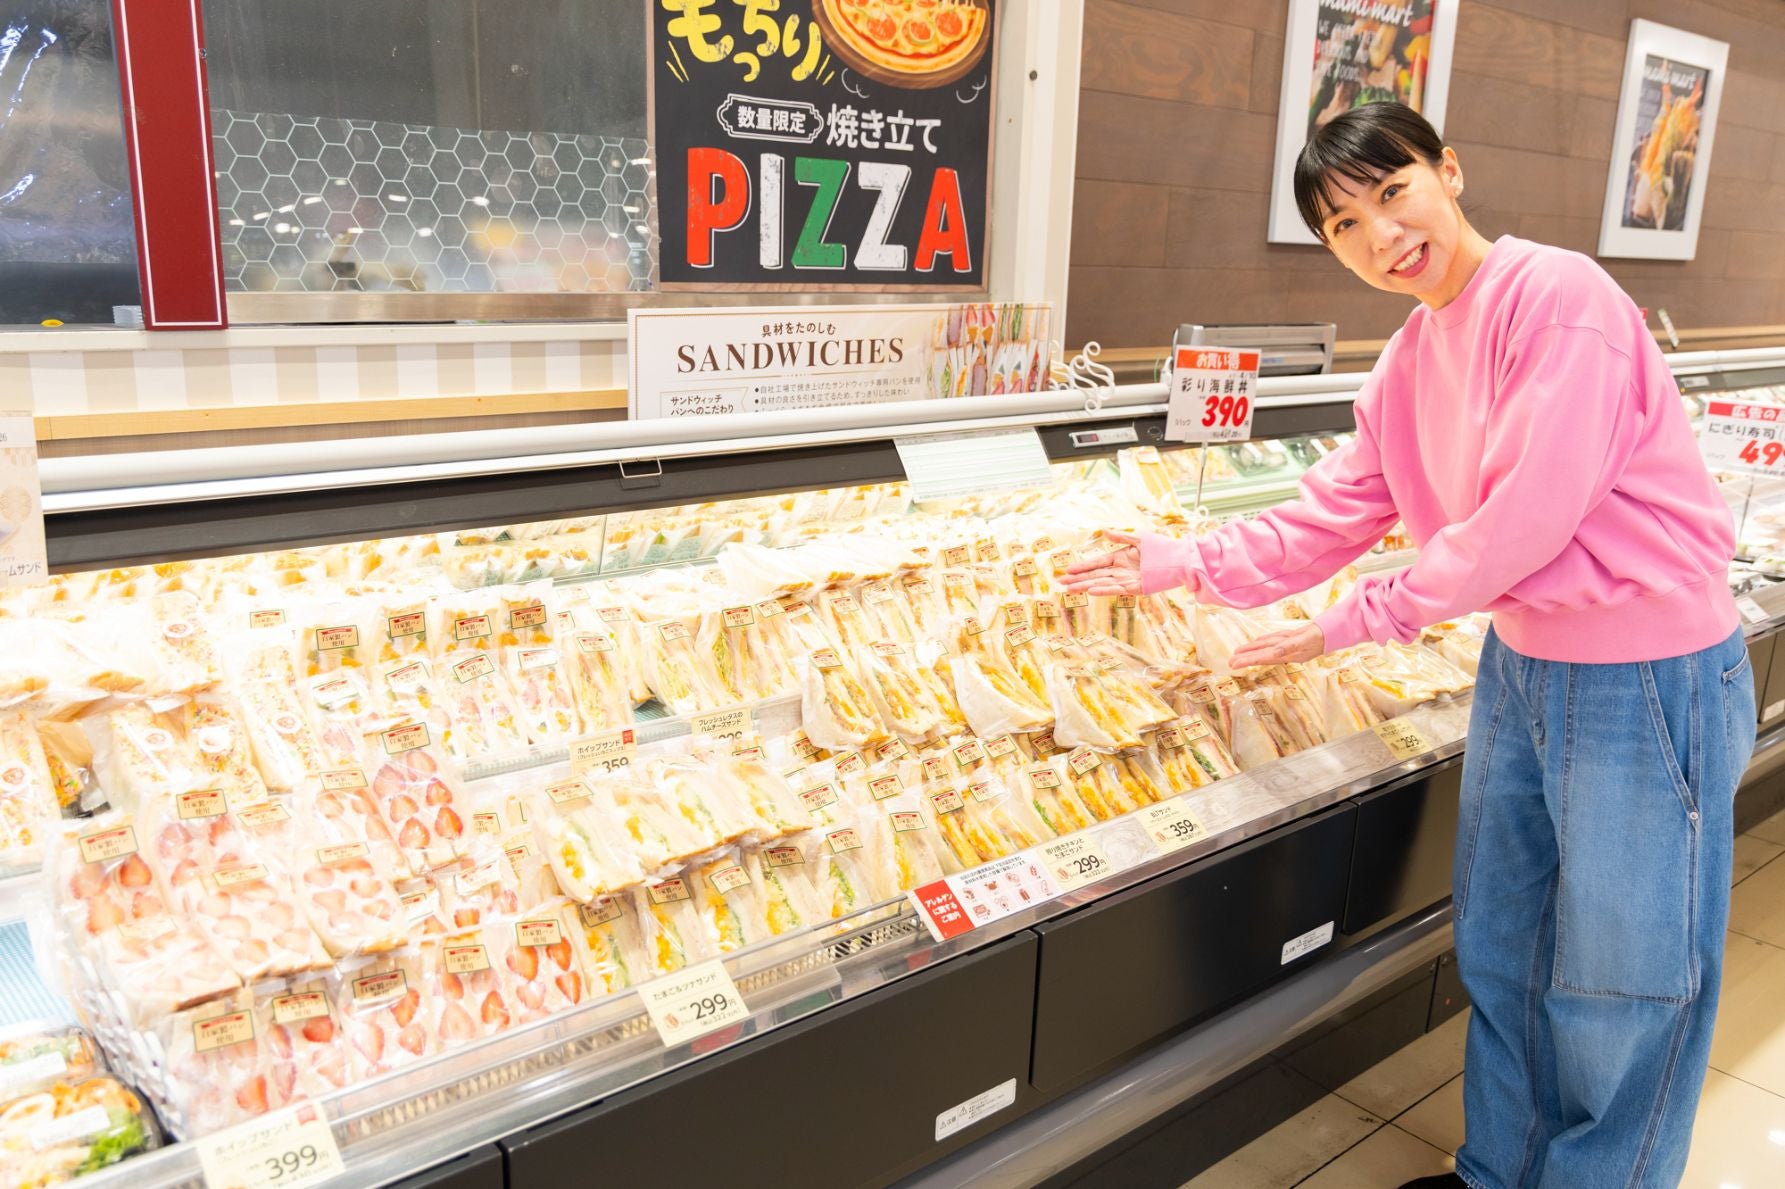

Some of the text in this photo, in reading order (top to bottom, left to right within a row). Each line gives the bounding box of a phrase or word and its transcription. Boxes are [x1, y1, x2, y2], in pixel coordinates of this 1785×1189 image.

[738, 103, 942, 154] 数量限定 焼き立て
[687, 147, 972, 272] PIZZA
[762, 322, 836, 337] 具材をたのしむ
[677, 338, 904, 373] SANDWICHES
[1196, 352, 1240, 370] お買い得
[671, 394, 722, 406] サンドウィッチ
[671, 404, 734, 416] パンへのこだわり
[1201, 395, 1248, 427] 390
[1738, 440, 1785, 466] 49
[699, 711, 743, 726] フレッシュレタスの
[701, 719, 741, 732] ハムチーズサンド
[578, 739, 620, 754] ホイップサンド
[924, 893, 953, 908] アレルゲン
[932, 901, 958, 916] に関する
[215, 1121, 292, 1155] ホイップサンド
